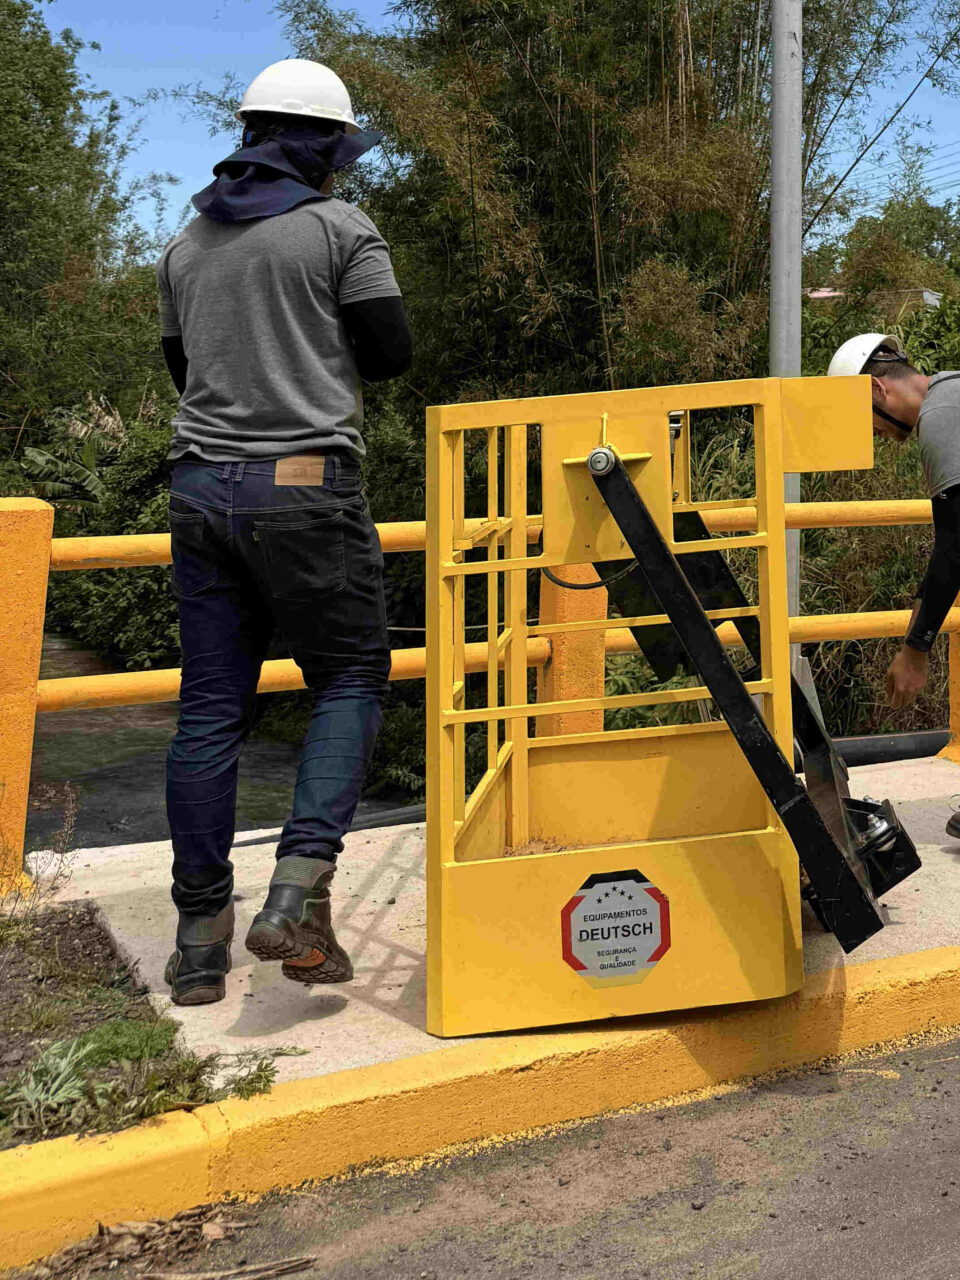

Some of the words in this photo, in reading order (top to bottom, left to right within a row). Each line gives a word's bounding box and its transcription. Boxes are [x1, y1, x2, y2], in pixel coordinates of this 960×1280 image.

[583, 908, 648, 922] EQUIPAMENTOS
[578, 922, 653, 942] DEUTSCH
[599, 960, 636, 970] QUALIDADE
